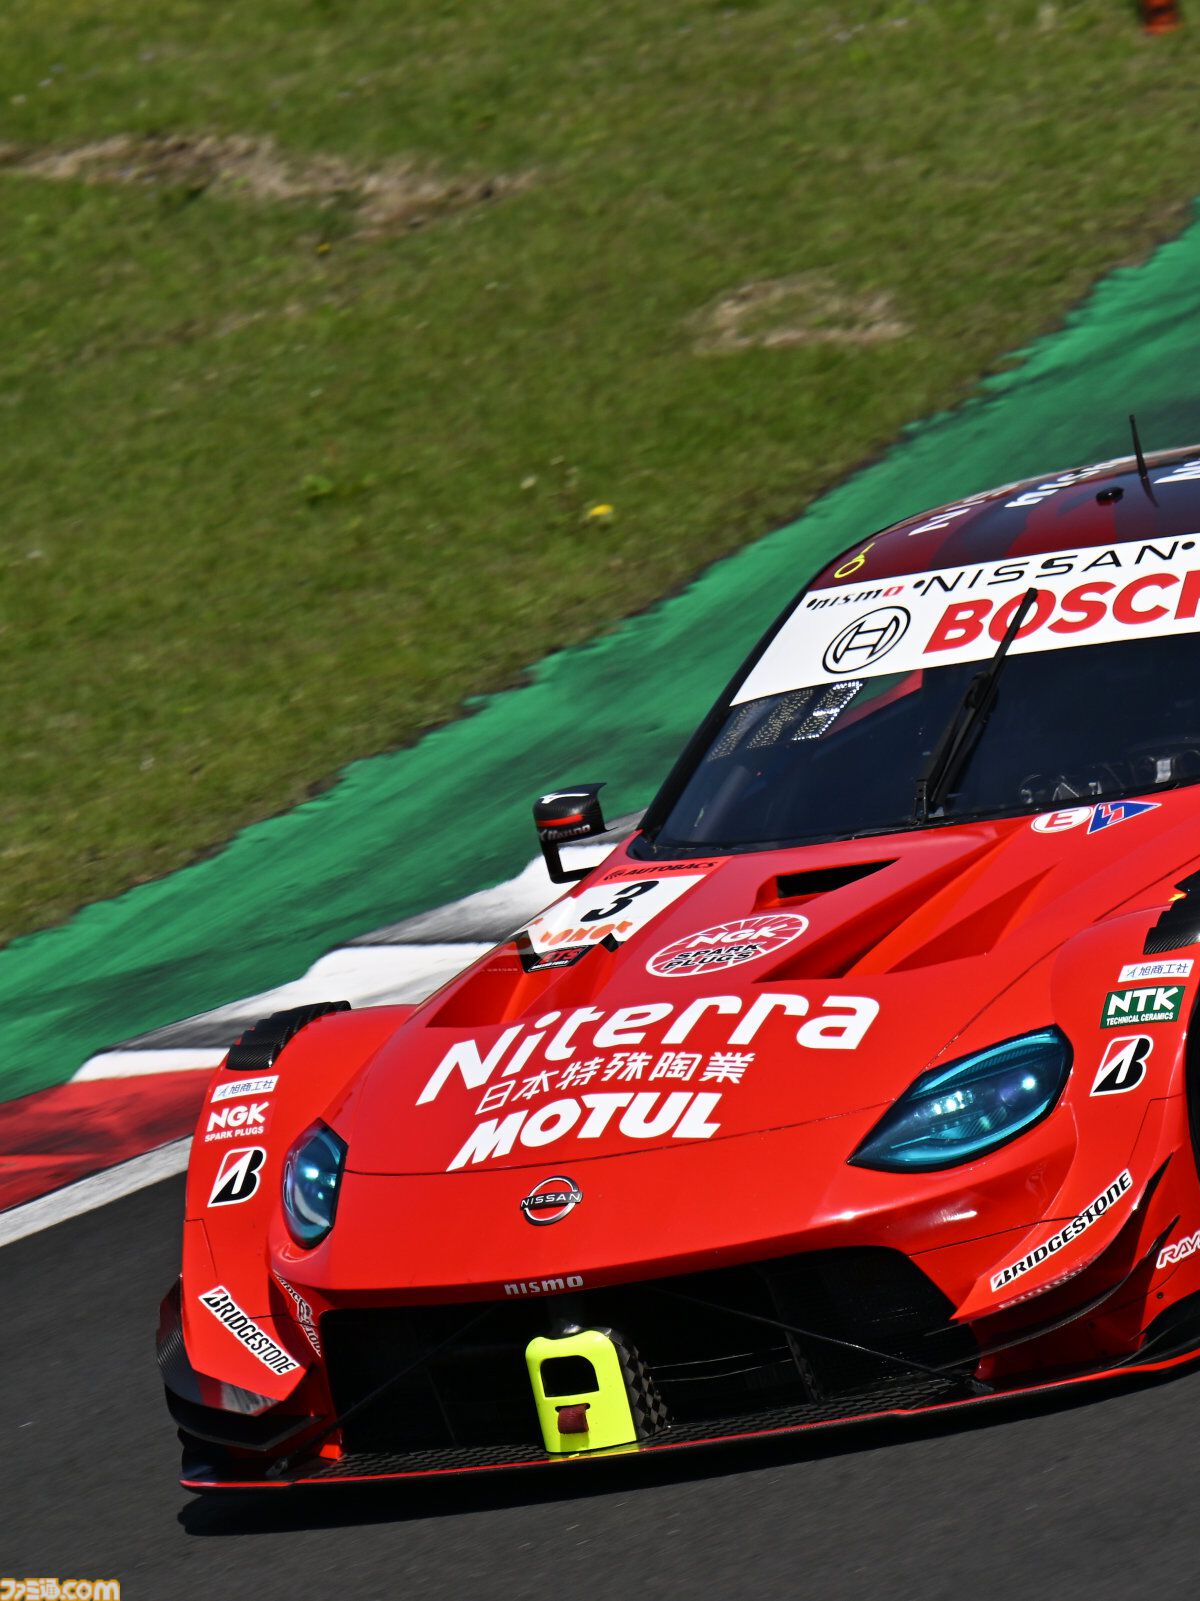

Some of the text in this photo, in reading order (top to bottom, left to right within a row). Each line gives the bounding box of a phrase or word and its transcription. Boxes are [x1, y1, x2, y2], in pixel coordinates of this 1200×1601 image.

[811, 586, 905, 611] nismo
[920, 540, 1180, 597] NISSAN
[579, 880, 660, 923] 3
[673, 941, 762, 961] SPARK
[686, 923, 788, 949] NGK
[662, 950, 753, 971] PLUGS
[1107, 987, 1179, 1016] NTK
[1106, 1011, 1174, 1027] TECHNICAL CERAMICS
[415, 993, 881, 1106] Niterra
[475, 1051, 756, 1116] 日本特殊陶業
[206, 1101, 270, 1132] NGK
[204, 1126, 265, 1143] SPARK PLUGS
[446, 1091, 723, 1173] MOTUL
[520, 1192, 582, 1209] NISSAN
[993, 1171, 1133, 1290] BRIDGESTONE
[503, 1275, 584, 1296] nismo
[201, 1287, 299, 1375] BRIDGESTONE
